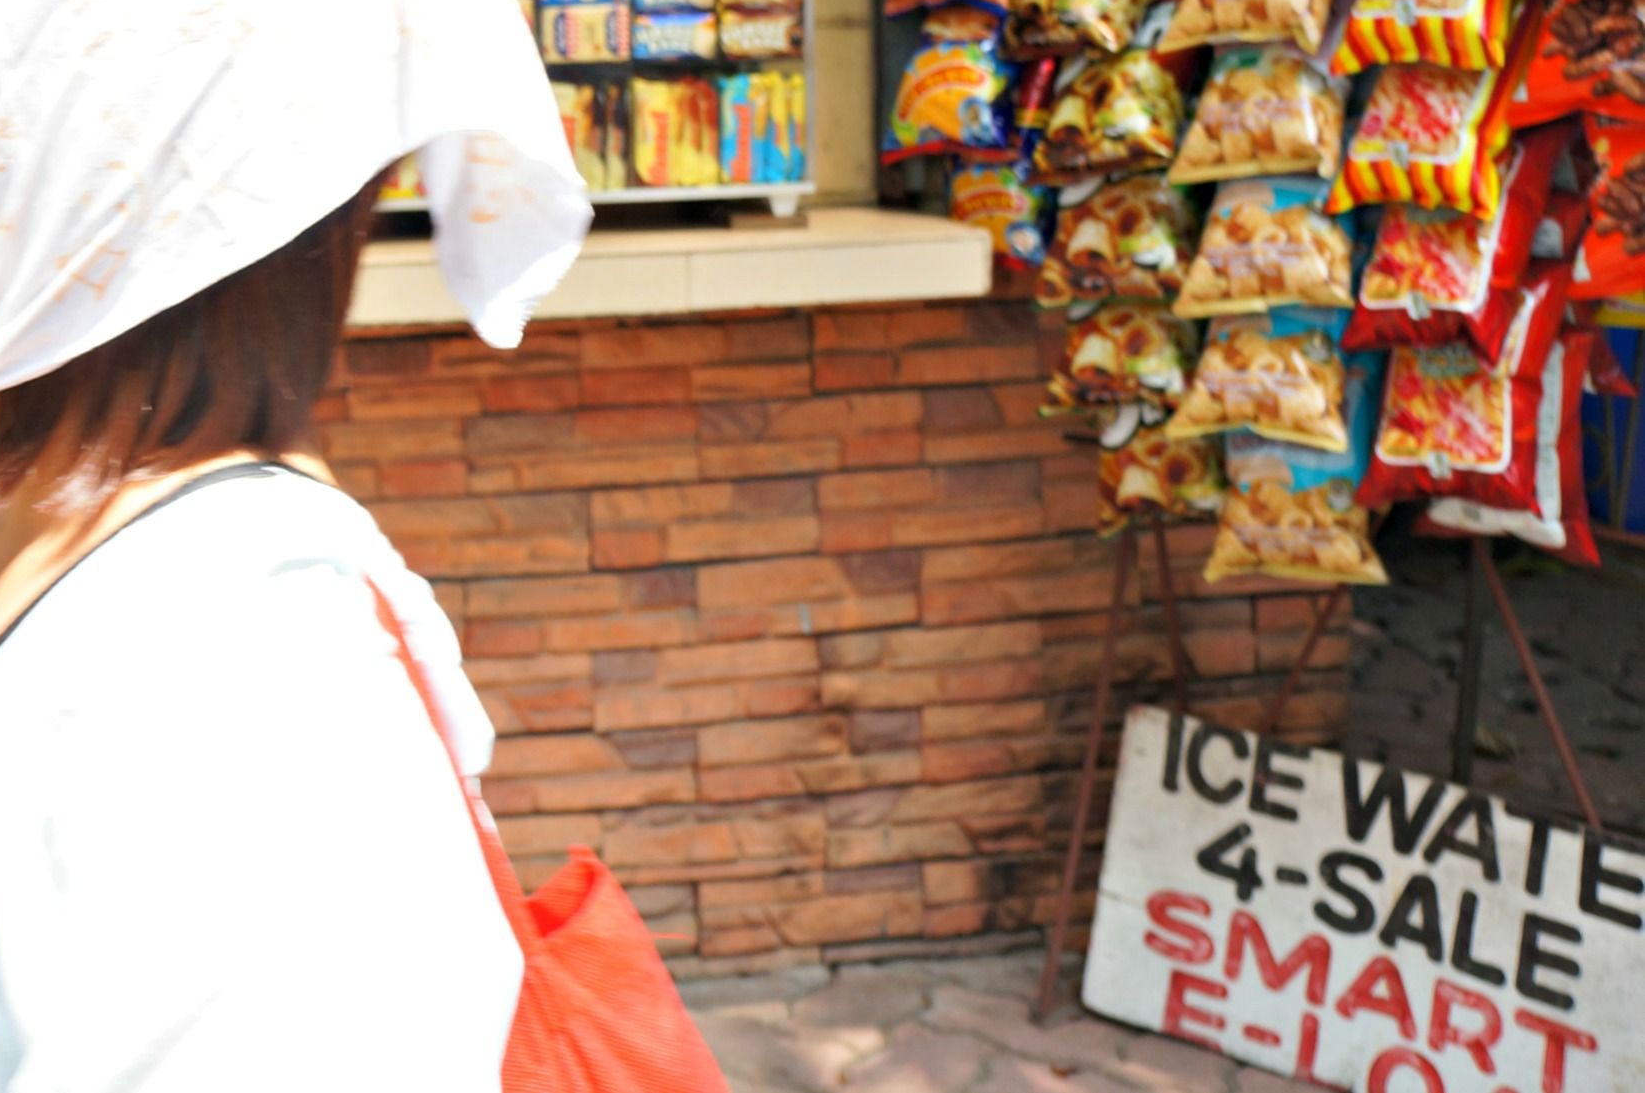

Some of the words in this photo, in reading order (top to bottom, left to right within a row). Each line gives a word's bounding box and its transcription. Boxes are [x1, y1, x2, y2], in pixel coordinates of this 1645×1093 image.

[1162, 711, 1311, 823] ICE
[1142, 889, 1599, 1093] SMART
[1196, 822, 1582, 1012] 4-SALE
